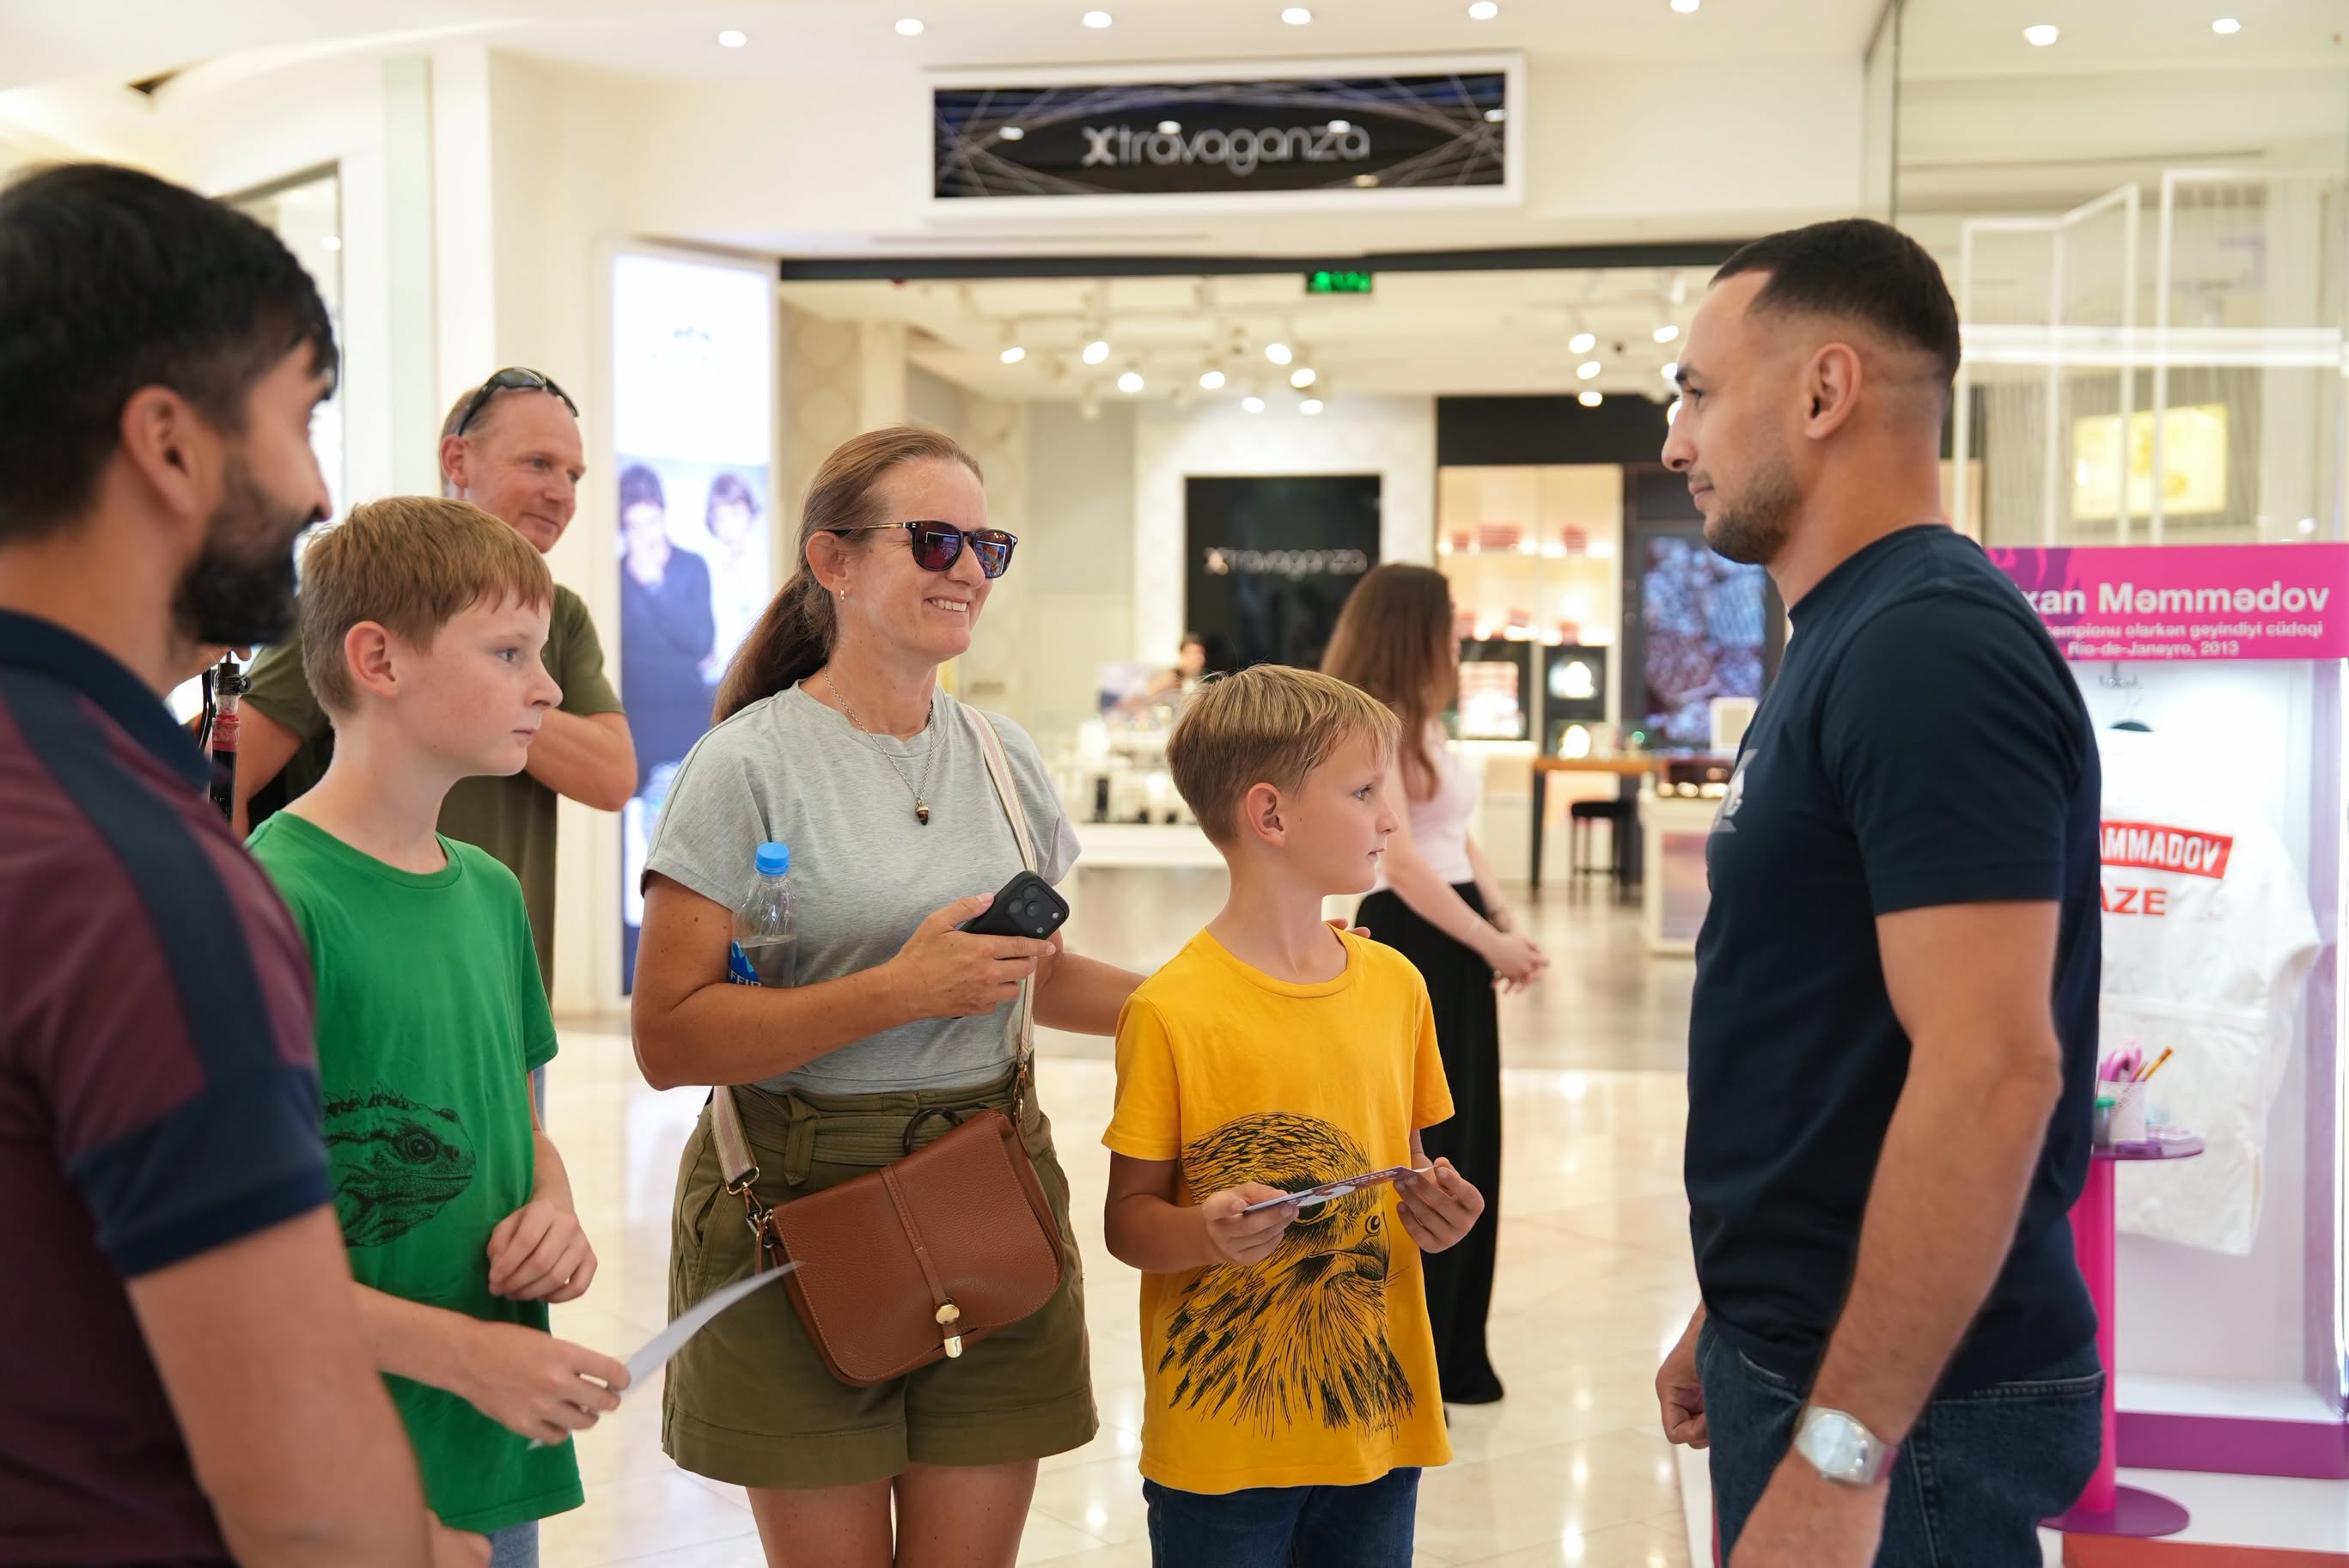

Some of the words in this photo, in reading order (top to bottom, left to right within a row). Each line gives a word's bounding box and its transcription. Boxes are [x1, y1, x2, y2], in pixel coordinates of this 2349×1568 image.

[2014, 583, 2086, 614] xan
[2097, 580, 2331, 613] Məmmədov
[2200, 639, 2240, 656] 2013
